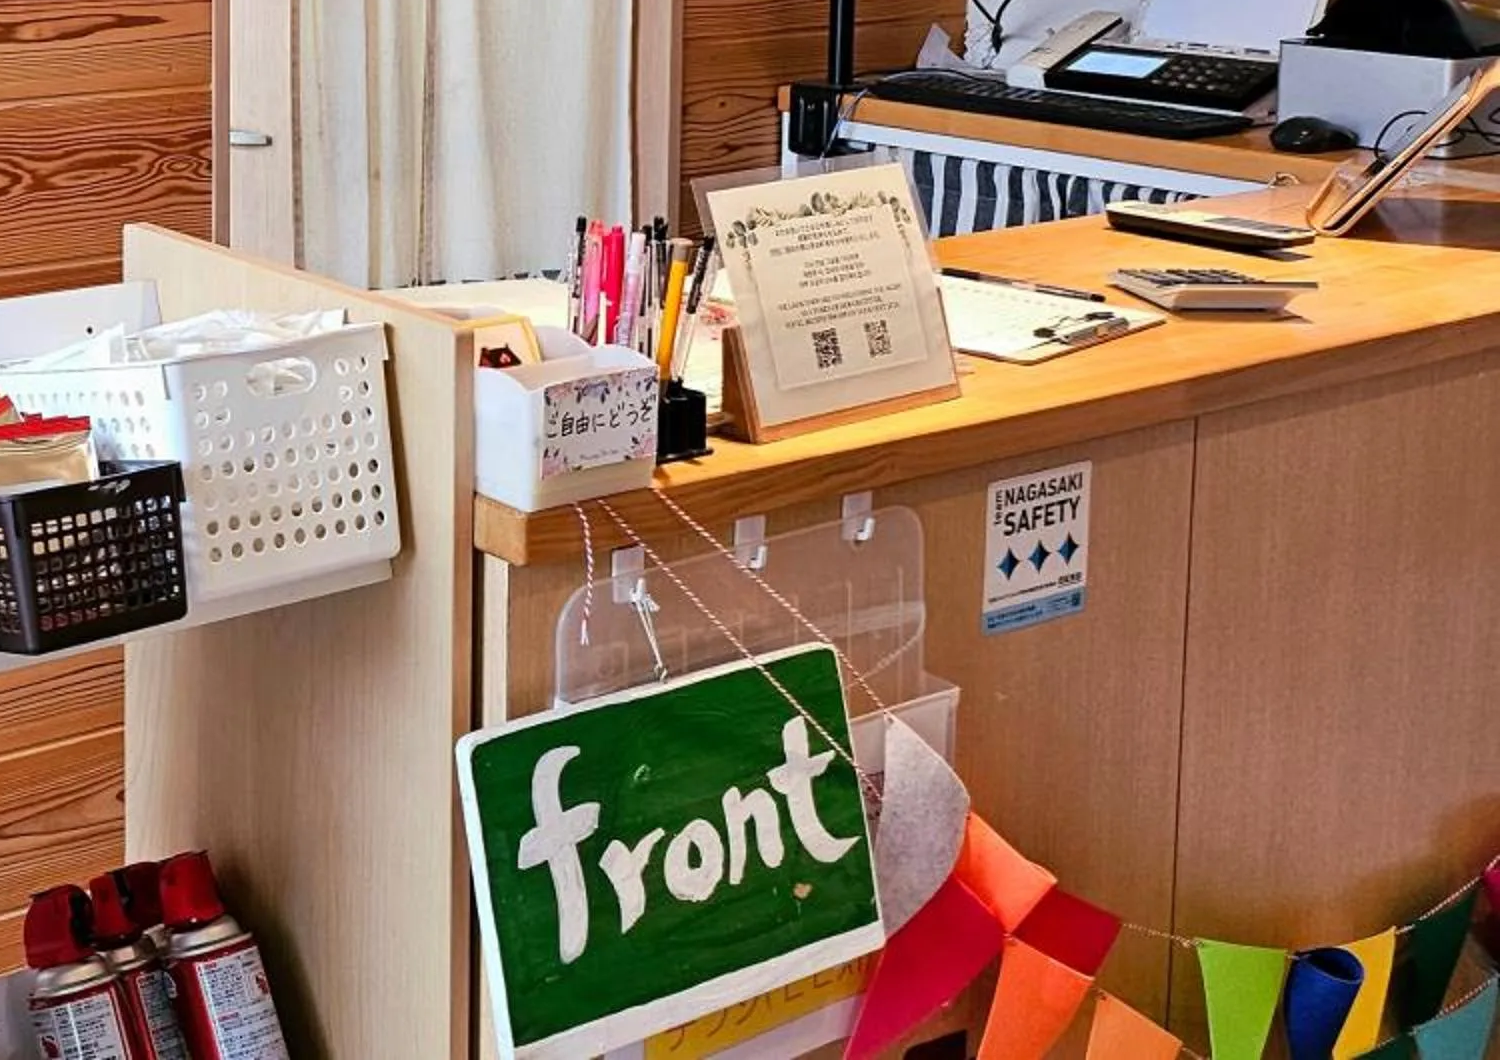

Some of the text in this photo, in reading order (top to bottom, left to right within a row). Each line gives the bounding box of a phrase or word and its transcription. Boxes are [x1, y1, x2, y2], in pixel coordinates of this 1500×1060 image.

[546, 393, 657, 439] ご自由にどうぞ
[1004, 471, 1084, 507] NAGASAKI
[1003, 496, 1082, 537] SAFETY
[518, 715, 861, 964] front
